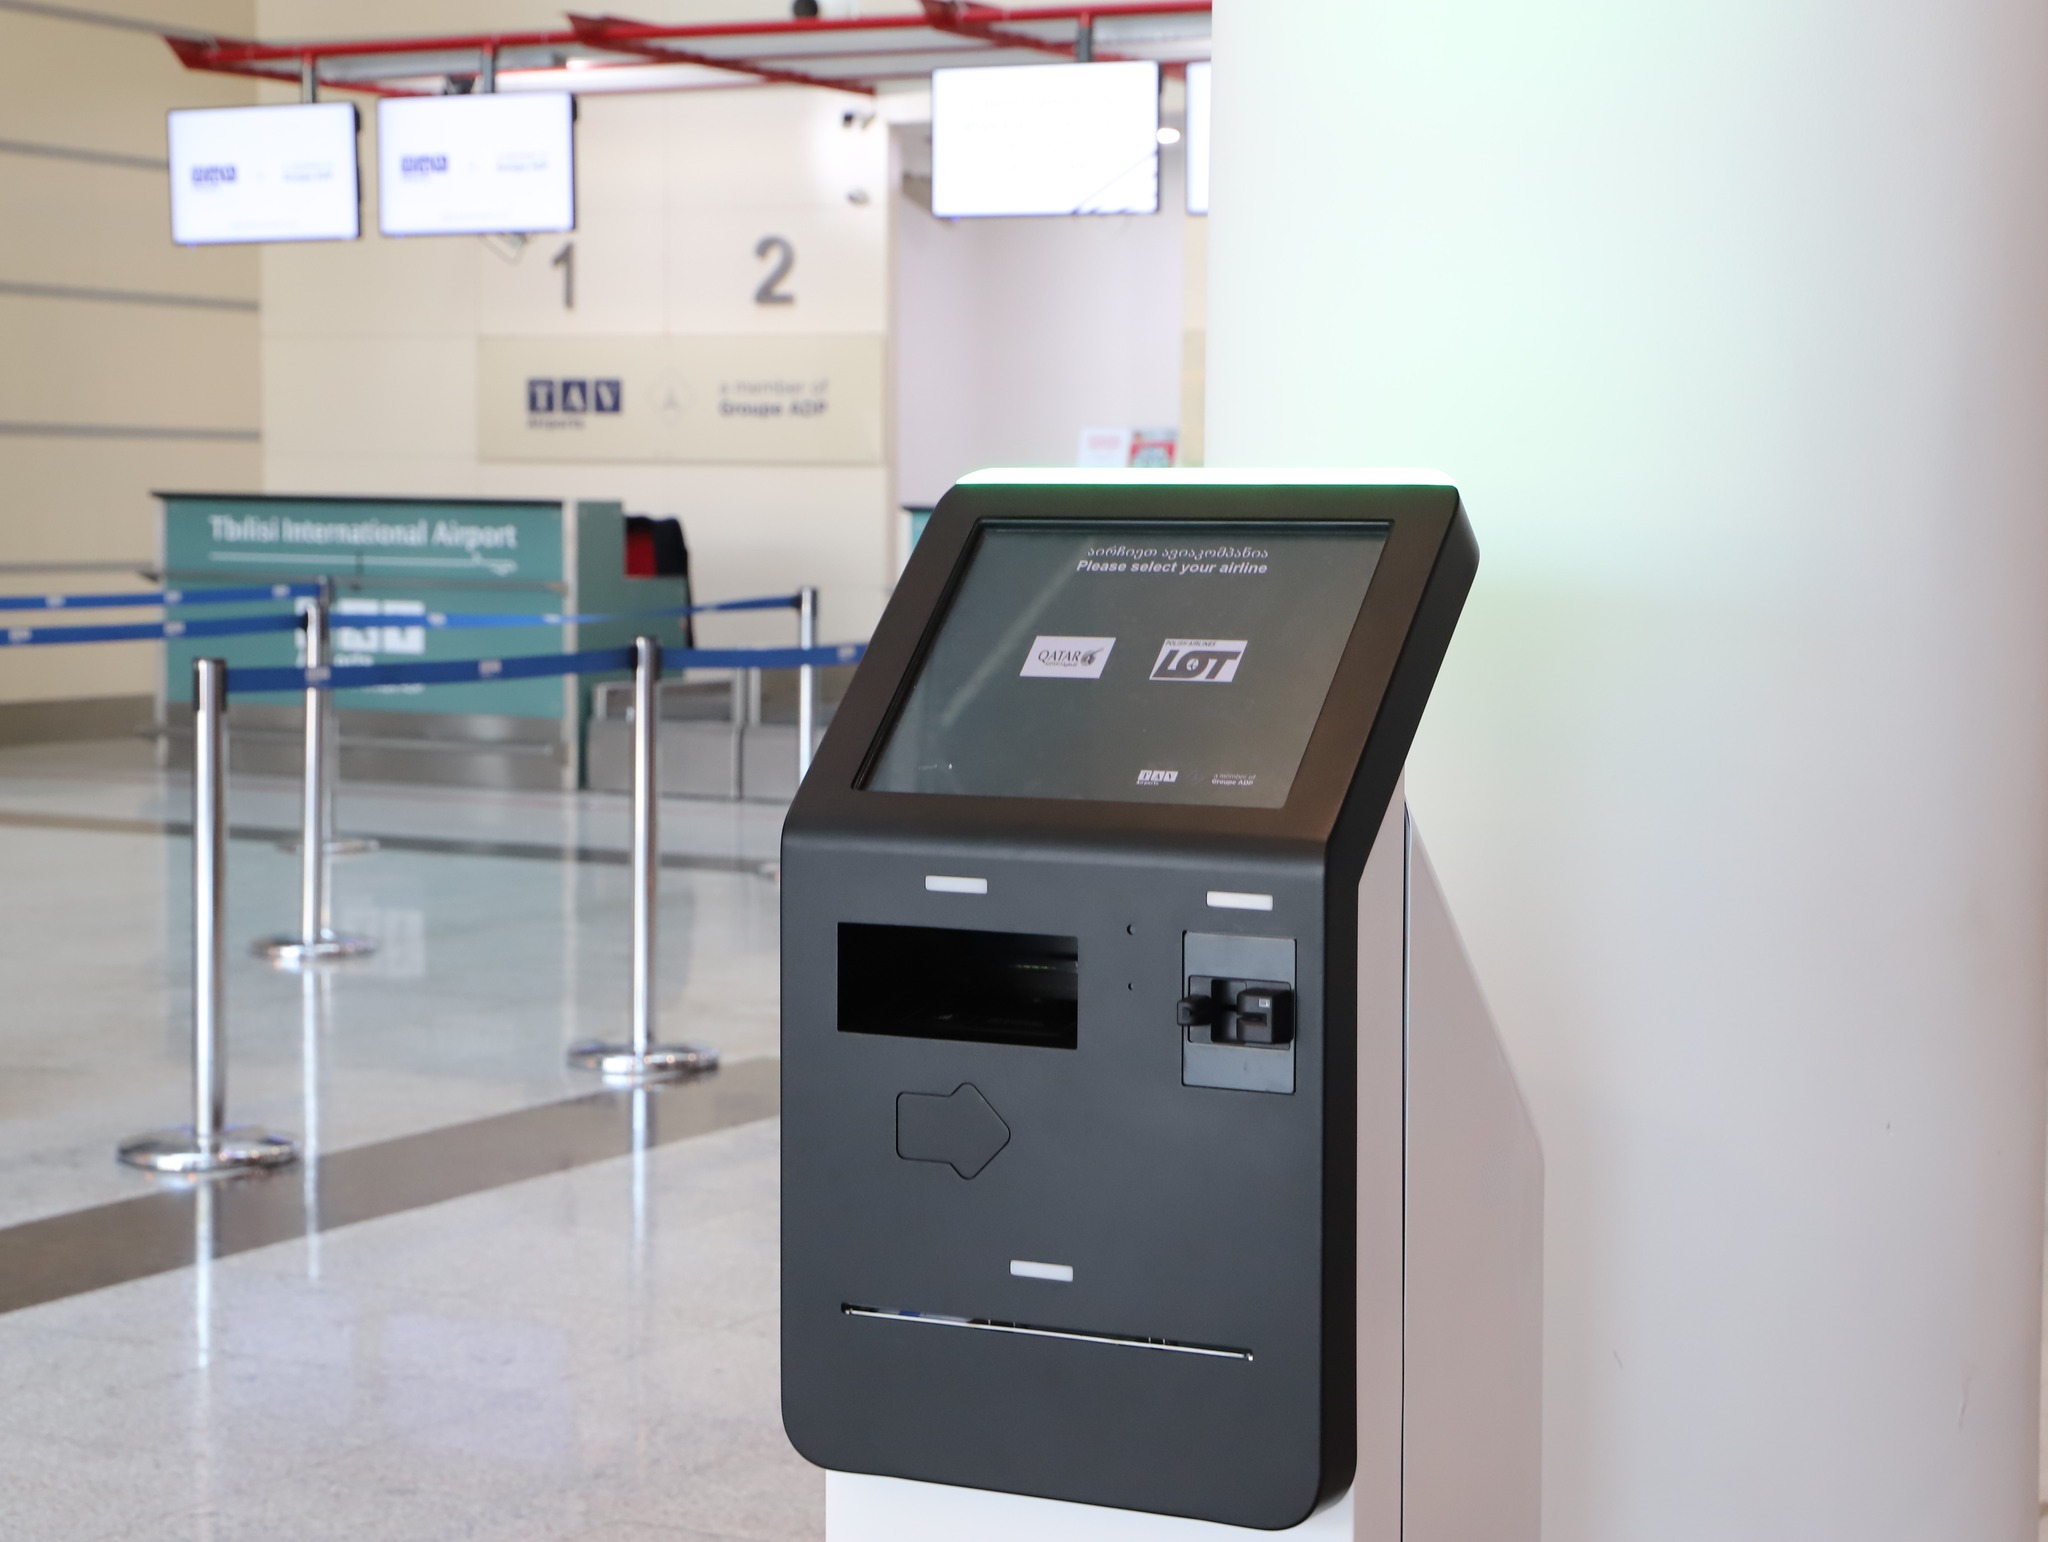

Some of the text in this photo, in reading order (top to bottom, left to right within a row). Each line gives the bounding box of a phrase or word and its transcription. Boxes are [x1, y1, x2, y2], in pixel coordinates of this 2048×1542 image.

[551, 241, 575, 310] 1
[754, 235, 795, 304] 2
[528, 379, 621, 413] TAV
[208, 514, 518, 553] Tbilisi International Airport
[1076, 559, 1268, 576] Please select your airline
[1038, 650, 1081, 663] QATAR
[1152, 650, 1241, 679] LOT
[1137, 770, 1178, 782] TAV
